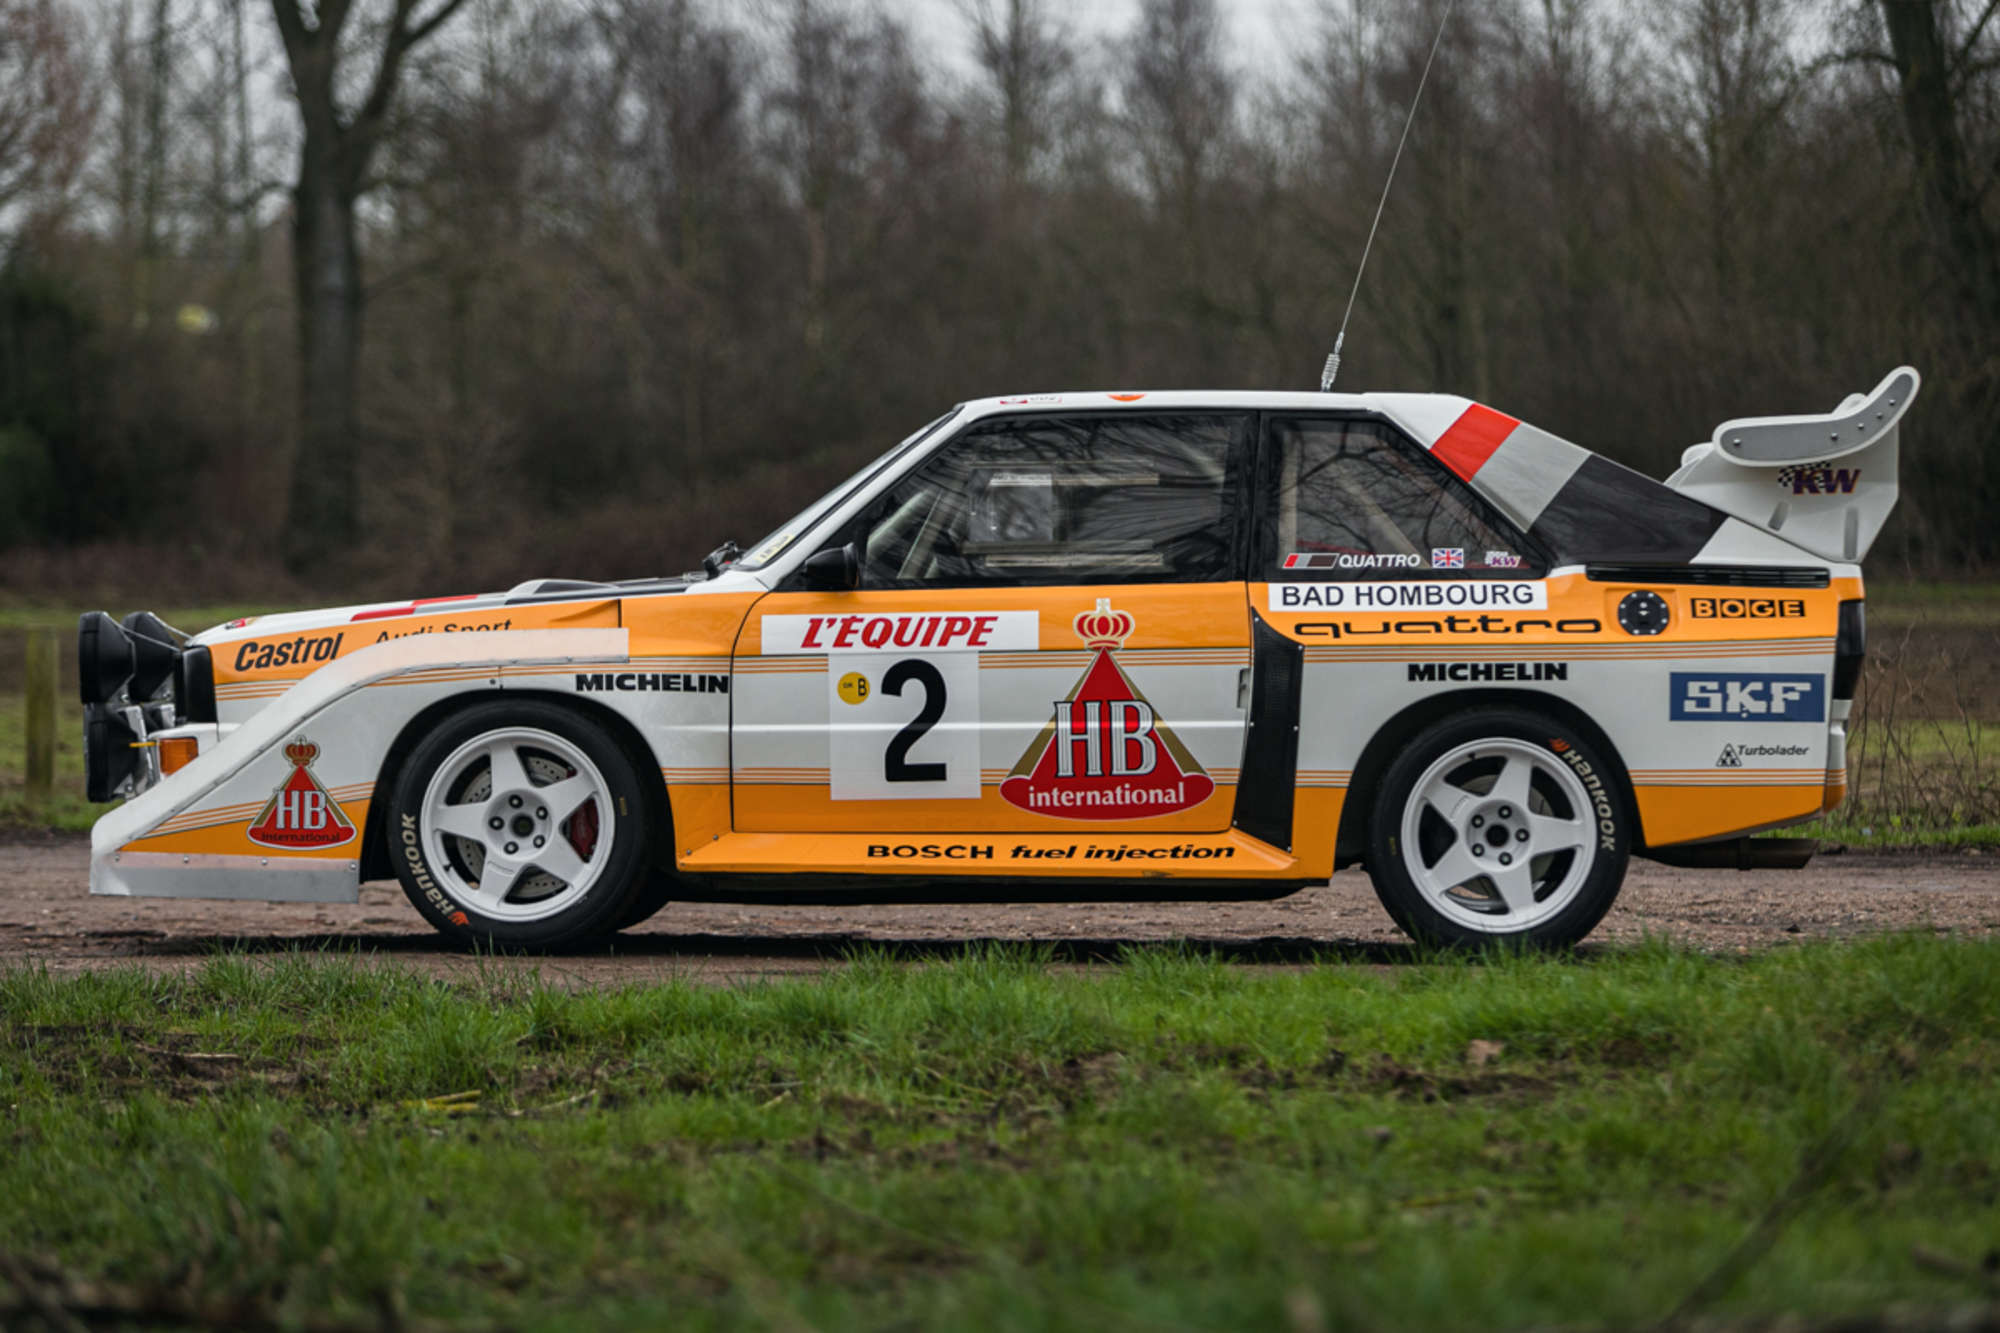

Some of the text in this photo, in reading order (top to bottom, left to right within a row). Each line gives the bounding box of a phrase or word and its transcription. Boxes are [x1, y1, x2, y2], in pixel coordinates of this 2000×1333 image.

[1793, 469, 1861, 495] KW
[1338, 553, 1421, 568] QUATTRO
[1282, 584, 1534, 607] BAD HOMBOURG
[1694, 600, 1804, 618] BOGE
[1294, 615, 1602, 639] quattro
[234, 633, 344, 672] Castrol
[576, 674, 729, 693] MICHELIN
[1408, 663, 1568, 682] MICHELIN
[857, 678, 867, 697] B
[1684, 681, 1812, 713] SKF
[881, 659, 947, 782] 2
[1054, 700, 1158, 778] HB
[1738, 744, 1810, 756] Turbolader
[1028, 782, 1184, 807] international
[274, 790, 327, 829] HB
[867, 844, 1236, 862] BOSCH fuel injection
